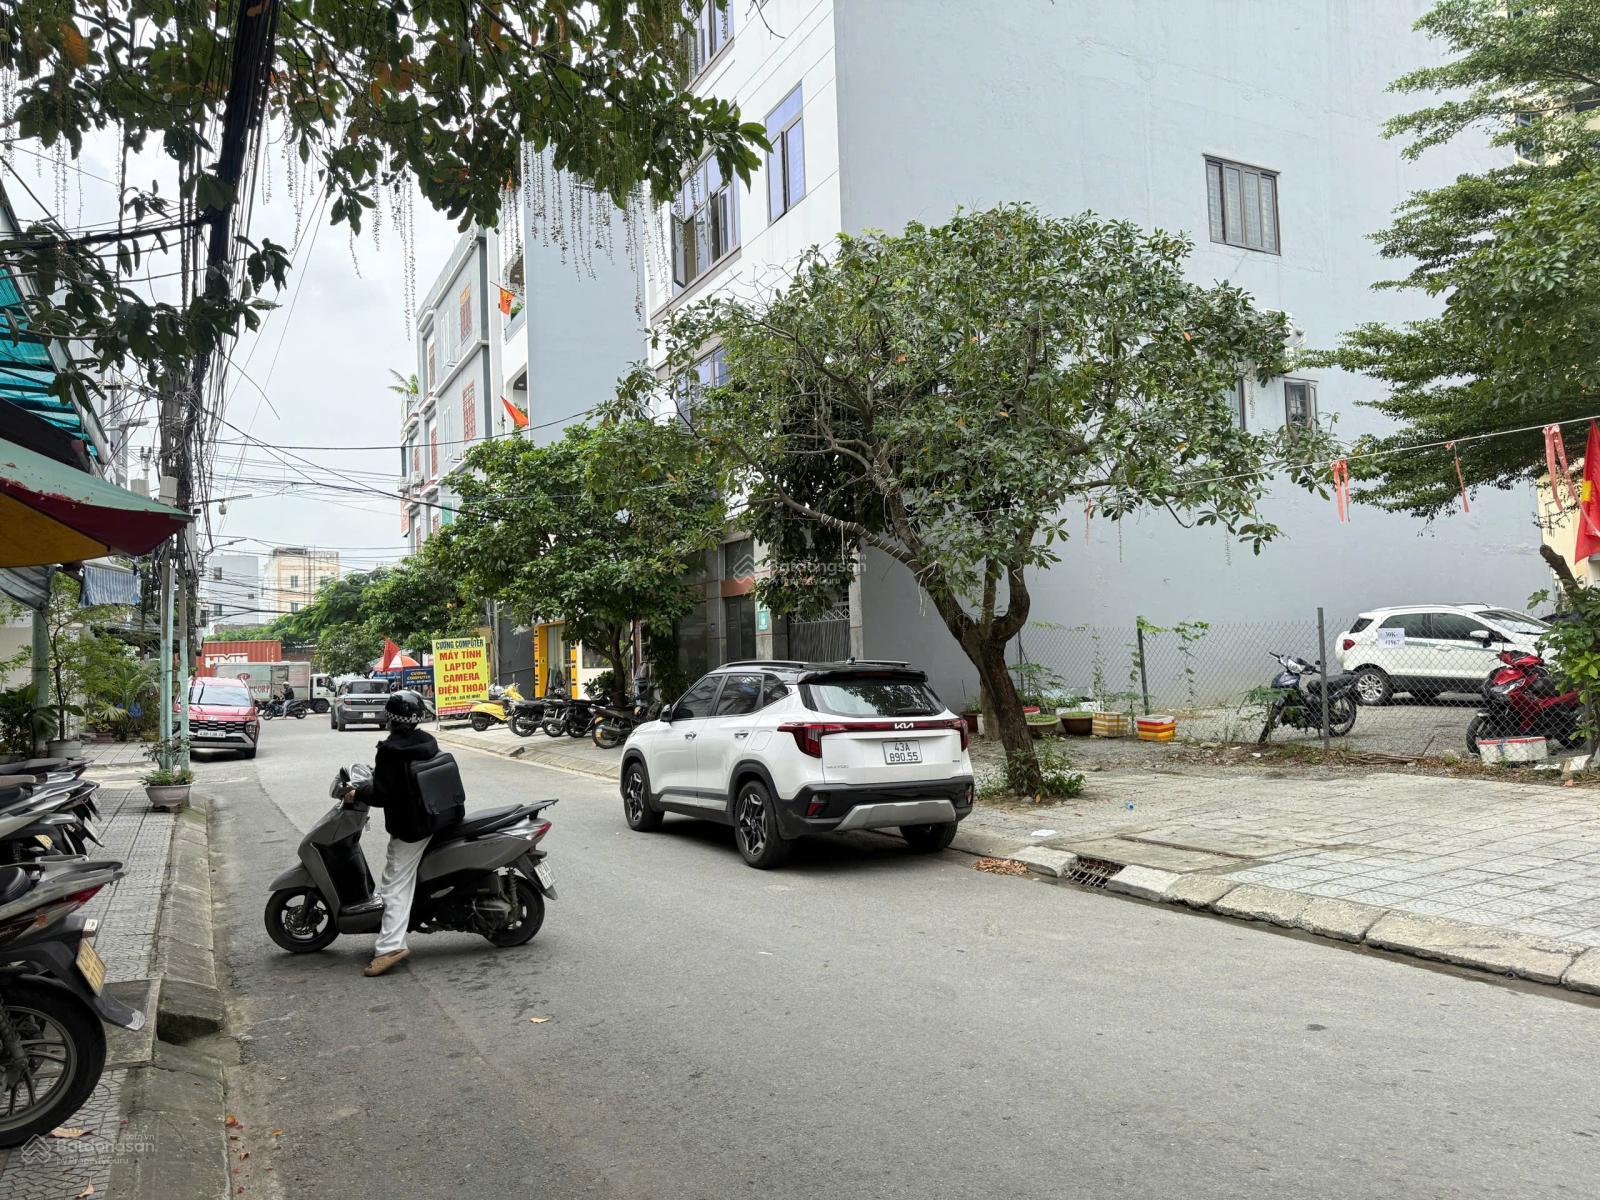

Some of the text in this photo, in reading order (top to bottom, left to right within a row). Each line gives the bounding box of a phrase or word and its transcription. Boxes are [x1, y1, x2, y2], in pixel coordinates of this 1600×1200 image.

[455, 639, 484, 648] COMPUTER
[439, 649, 481, 660] MÁY TÍNH
[444, 661, 477, 672] LAPTOP
[443, 672, 480, 683] CAMERA
[438, 683, 487, 695] ĐIỆN THOẠI
[894, 742, 911, 751] 43A
